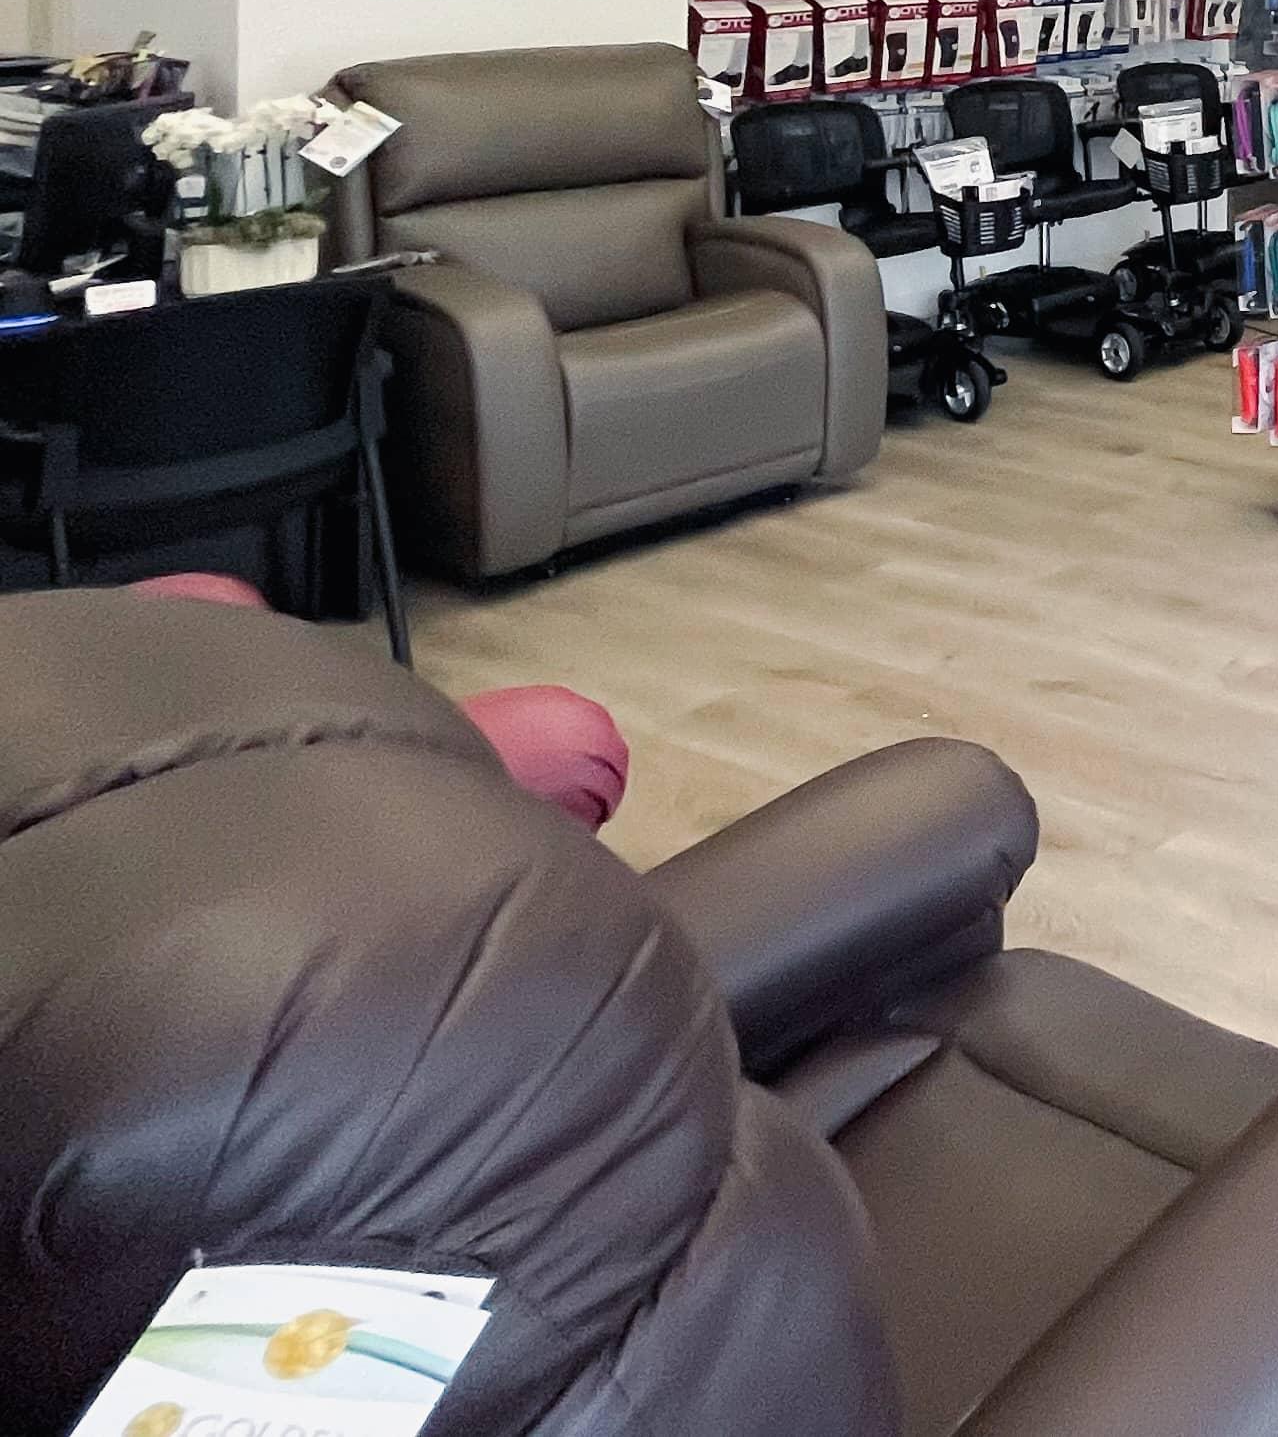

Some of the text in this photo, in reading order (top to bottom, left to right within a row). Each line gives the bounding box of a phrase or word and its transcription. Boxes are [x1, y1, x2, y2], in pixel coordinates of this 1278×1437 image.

[837, 5, 868, 17] OTC
[901, 5, 928, 15] OTC
[951, 3, 977, 13] OTC
[719, 18, 752, 29] OTC
[782, 12, 812, 24] OTC
